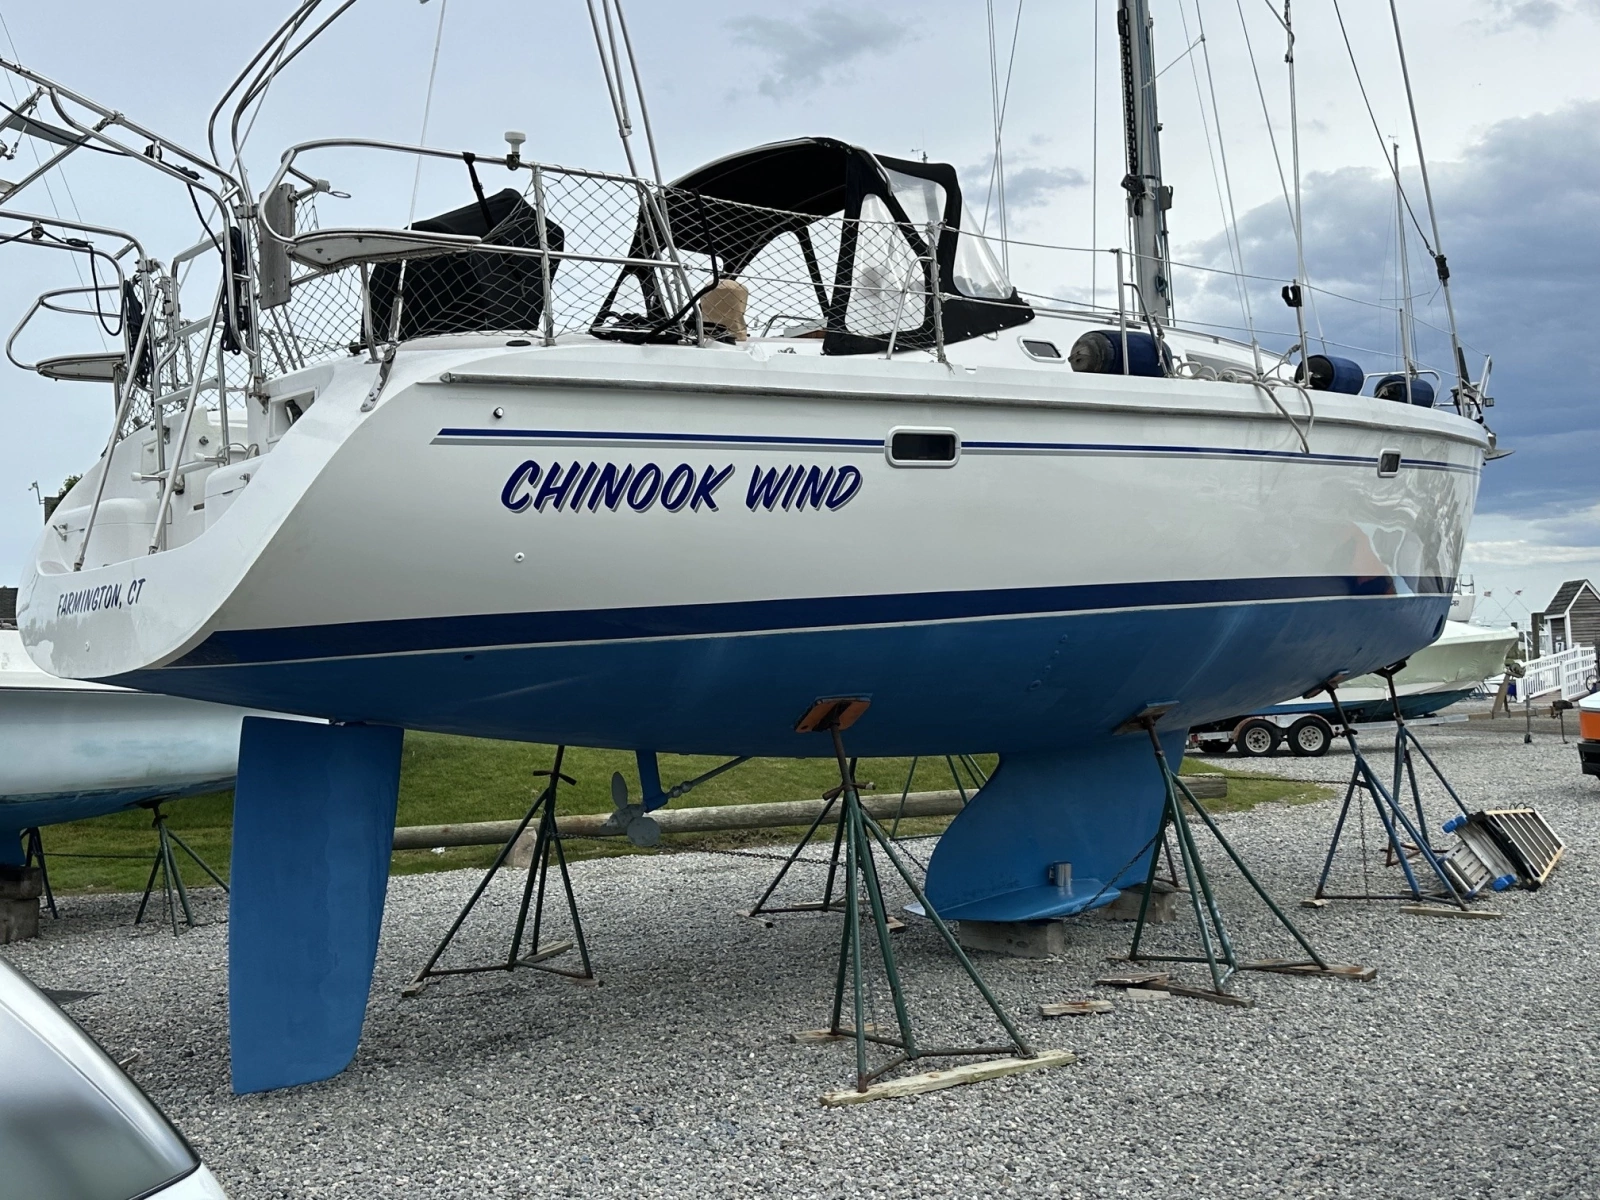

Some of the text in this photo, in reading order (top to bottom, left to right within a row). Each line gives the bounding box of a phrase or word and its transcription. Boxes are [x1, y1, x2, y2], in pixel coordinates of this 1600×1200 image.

[501, 460, 863, 513] CHINOOK WIND
[57, 578, 146, 617] FARMINGTON, CT
